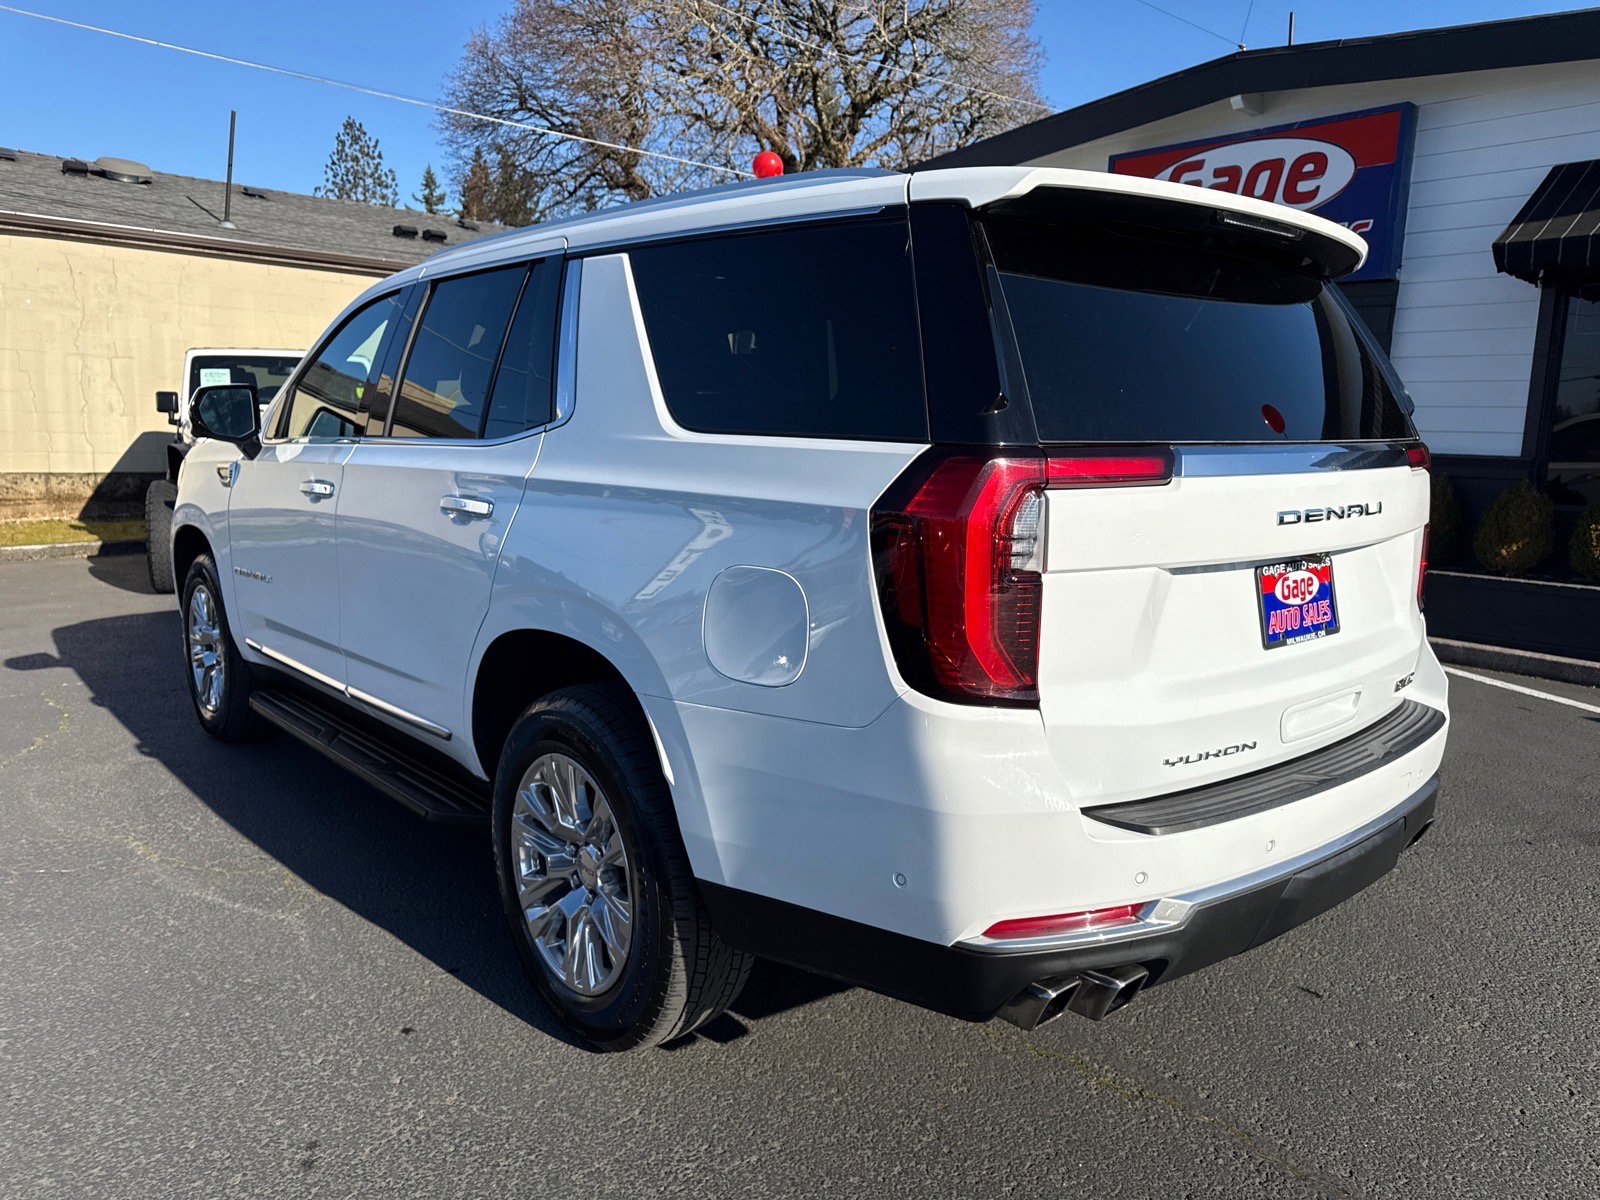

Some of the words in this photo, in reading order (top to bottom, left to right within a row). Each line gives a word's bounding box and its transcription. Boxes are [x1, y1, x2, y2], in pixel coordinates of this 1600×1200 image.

[1277, 501, 1382, 526] DENALI
[1263, 564, 1286, 576] GAGE
[1287, 561, 1307, 572] AUTO
[1281, 576, 1314, 602] Gage
[1268, 606, 1301, 635] AUTO
[1303, 600, 1332, 627] SALES
[1163, 741, 1257, 767] YUKON
